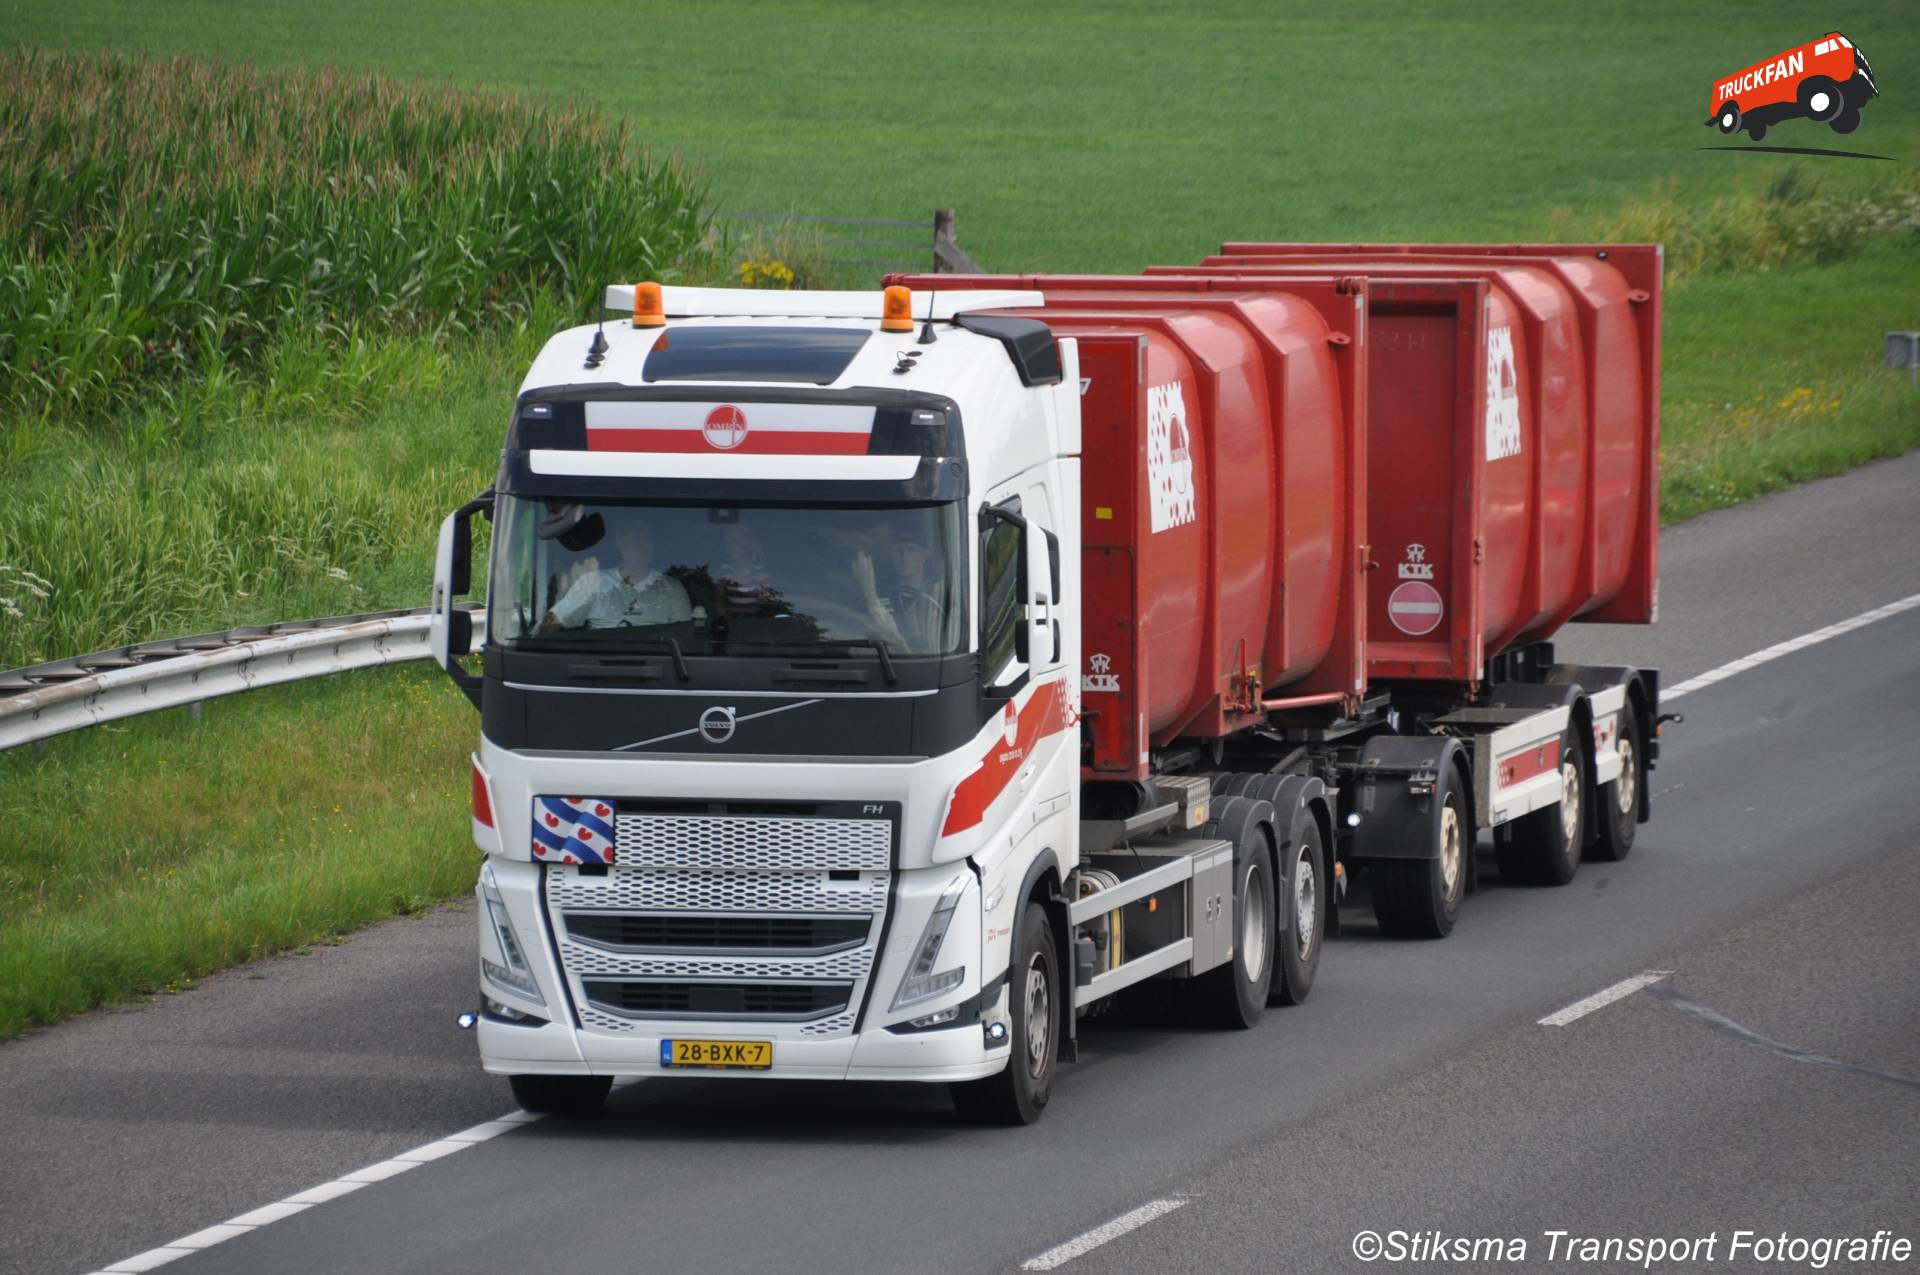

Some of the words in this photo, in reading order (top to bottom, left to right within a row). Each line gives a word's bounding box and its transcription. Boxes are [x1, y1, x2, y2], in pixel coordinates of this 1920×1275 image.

[1397, 562, 1434, 580] KTK
[1081, 674, 1120, 692] KTK
[862, 804, 884, 815] FH
[679, 1044, 764, 1062] 28-BXK-7
